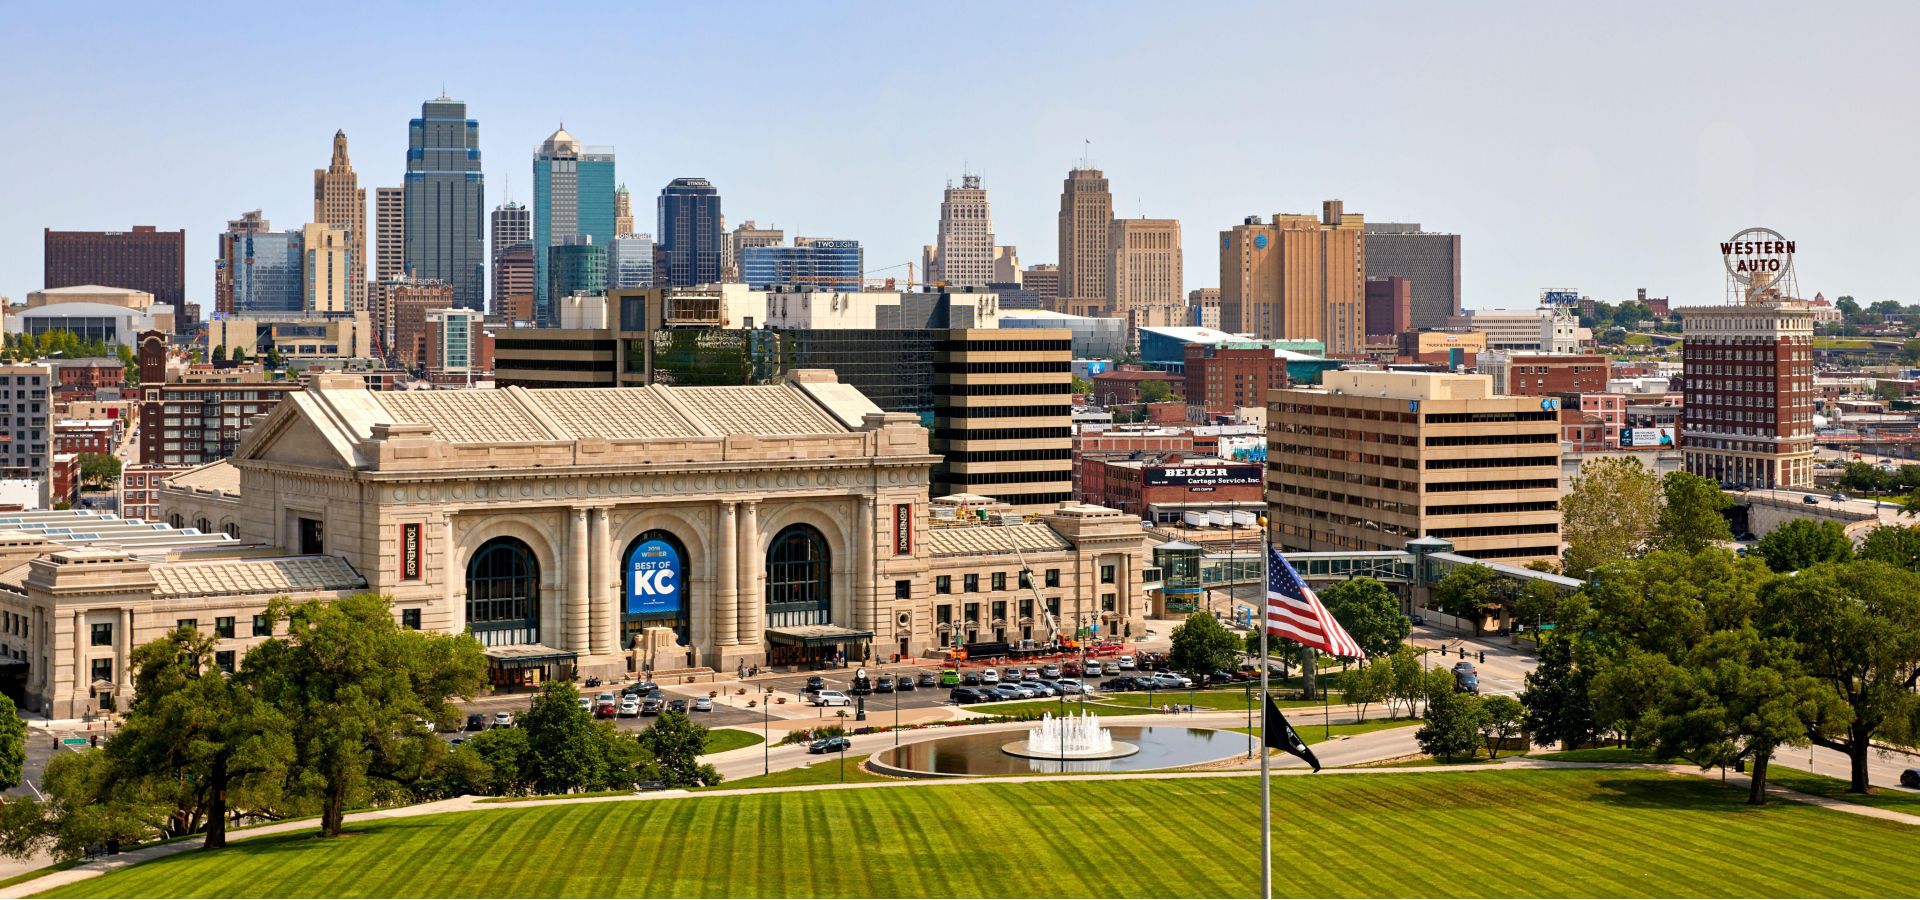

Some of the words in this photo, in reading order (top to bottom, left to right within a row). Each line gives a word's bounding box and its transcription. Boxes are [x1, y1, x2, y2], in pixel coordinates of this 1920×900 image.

[1720, 241, 1796, 255] WESTERN
[1737, 259, 1780, 272] AUTO
[1164, 468, 1229, 477] BELGER
[1187, 477, 1216, 485] Cartage
[407, 527, 416, 576] STONEHENGE
[634, 562, 656, 570] BEST
[658, 561, 671, 569] OF
[634, 569, 675, 596] KC
